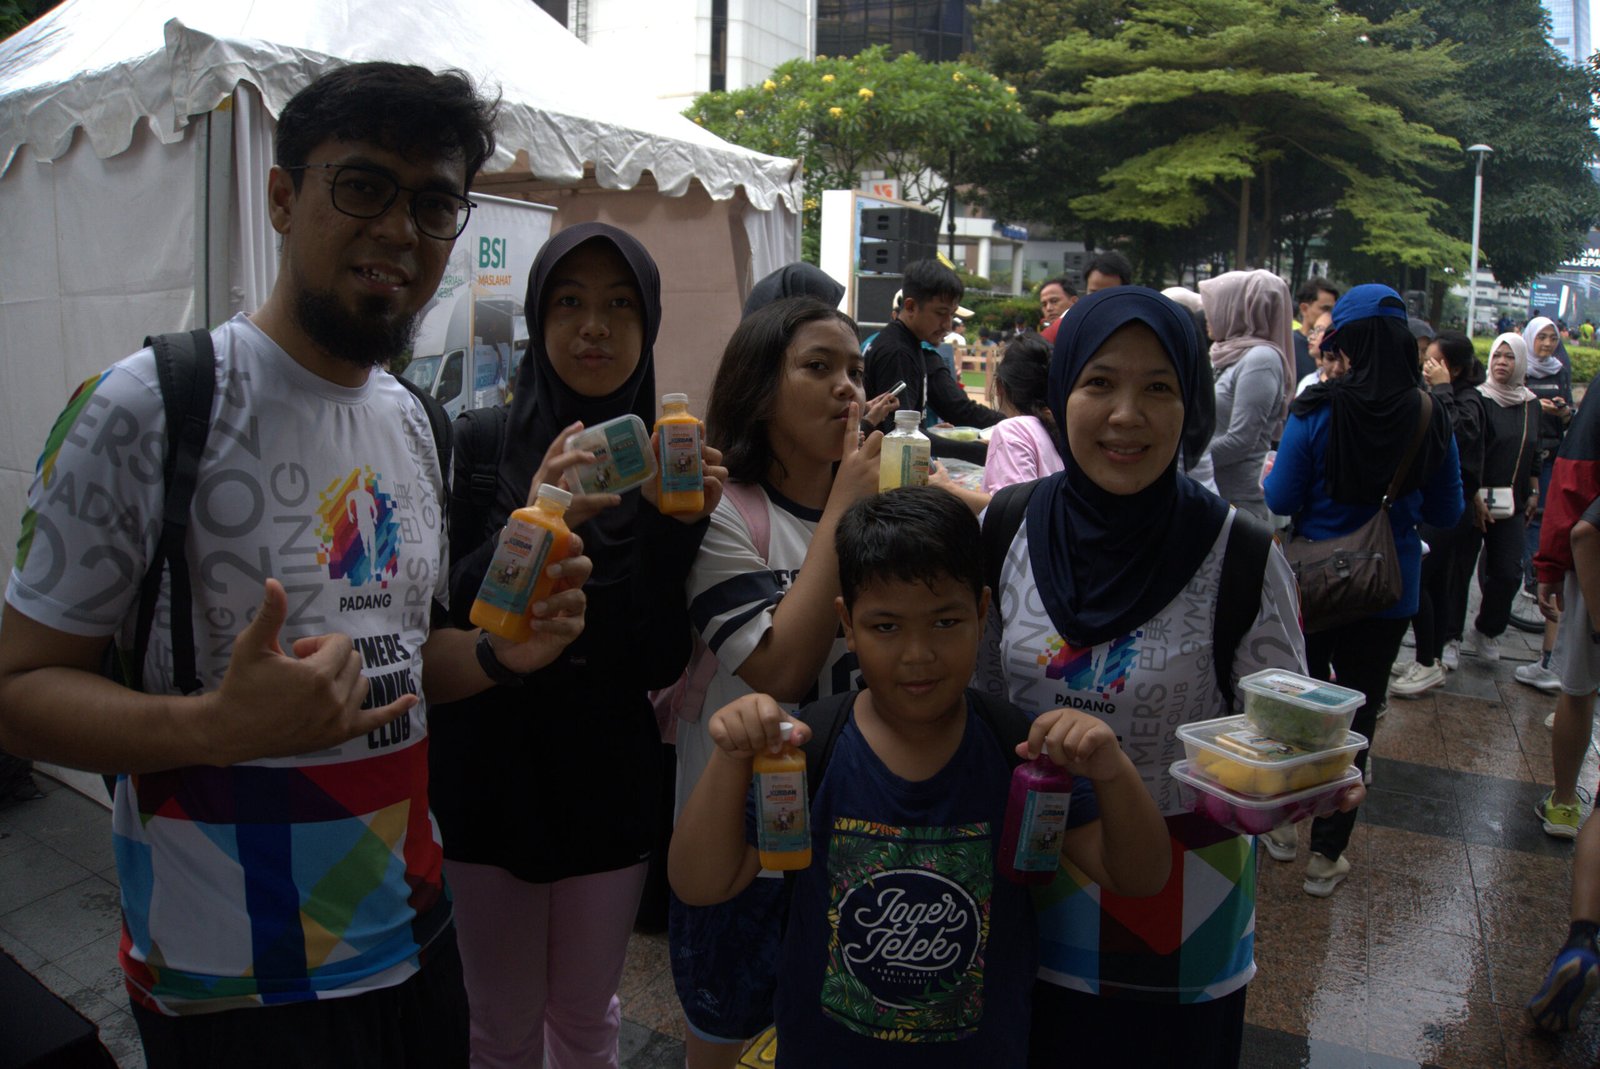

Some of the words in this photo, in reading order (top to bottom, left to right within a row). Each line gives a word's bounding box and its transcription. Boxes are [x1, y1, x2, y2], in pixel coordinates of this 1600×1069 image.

[479, 236, 506, 269] BSI
[478, 275, 512, 286] MASLAHAT
[340, 594, 392, 613] PADANG
[1055, 694, 1116, 714] PADANG
[1167, 682, 1188, 726] CLUB
